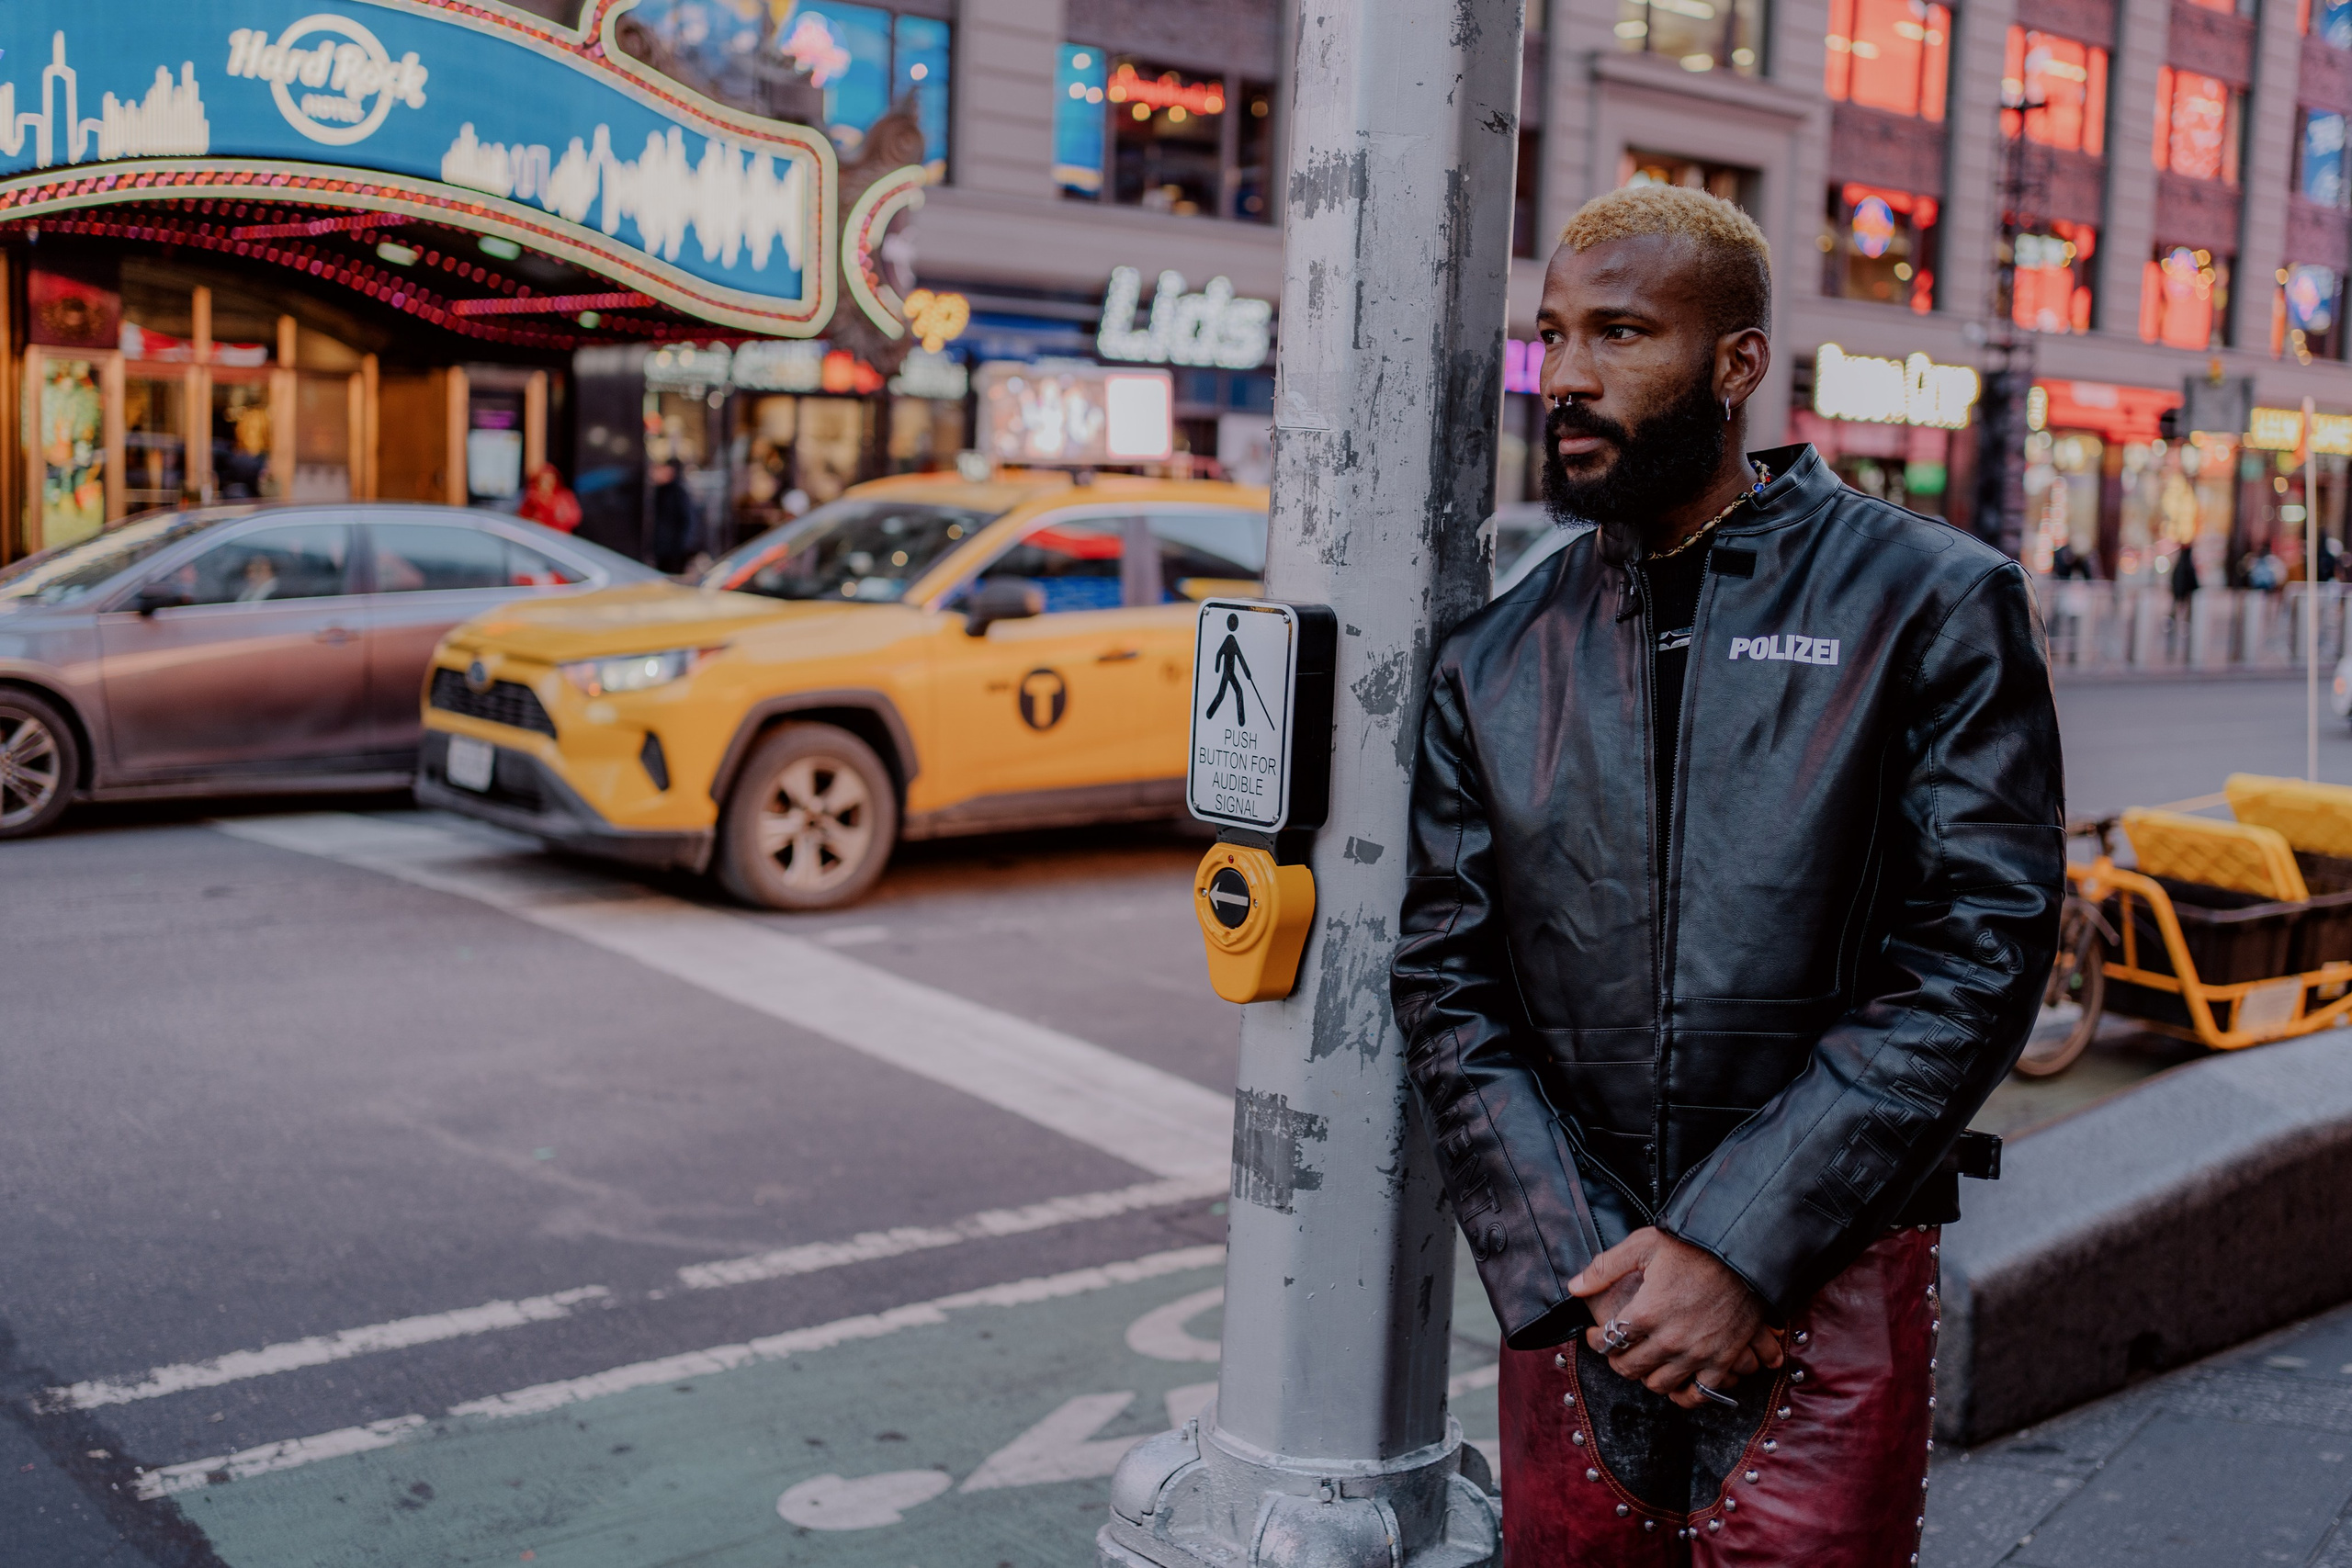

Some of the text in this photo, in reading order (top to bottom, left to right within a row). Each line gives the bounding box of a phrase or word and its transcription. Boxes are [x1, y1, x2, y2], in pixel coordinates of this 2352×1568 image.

[227, 28, 429, 109] Hard Rock
[1097, 265, 1272, 369] Lids
[1728, 634, 1839, 665] POLIZEI
[1022, 671, 1063, 729] T
[1224, 728, 1258, 750] PUSH
[1199, 747, 1276, 776] BUTTON FOR
[1212, 772, 1263, 796] AUDIBLE
[1215, 794, 1259, 818] SIGNAL
[1801, 927, 2024, 1228] VETEMENTS
